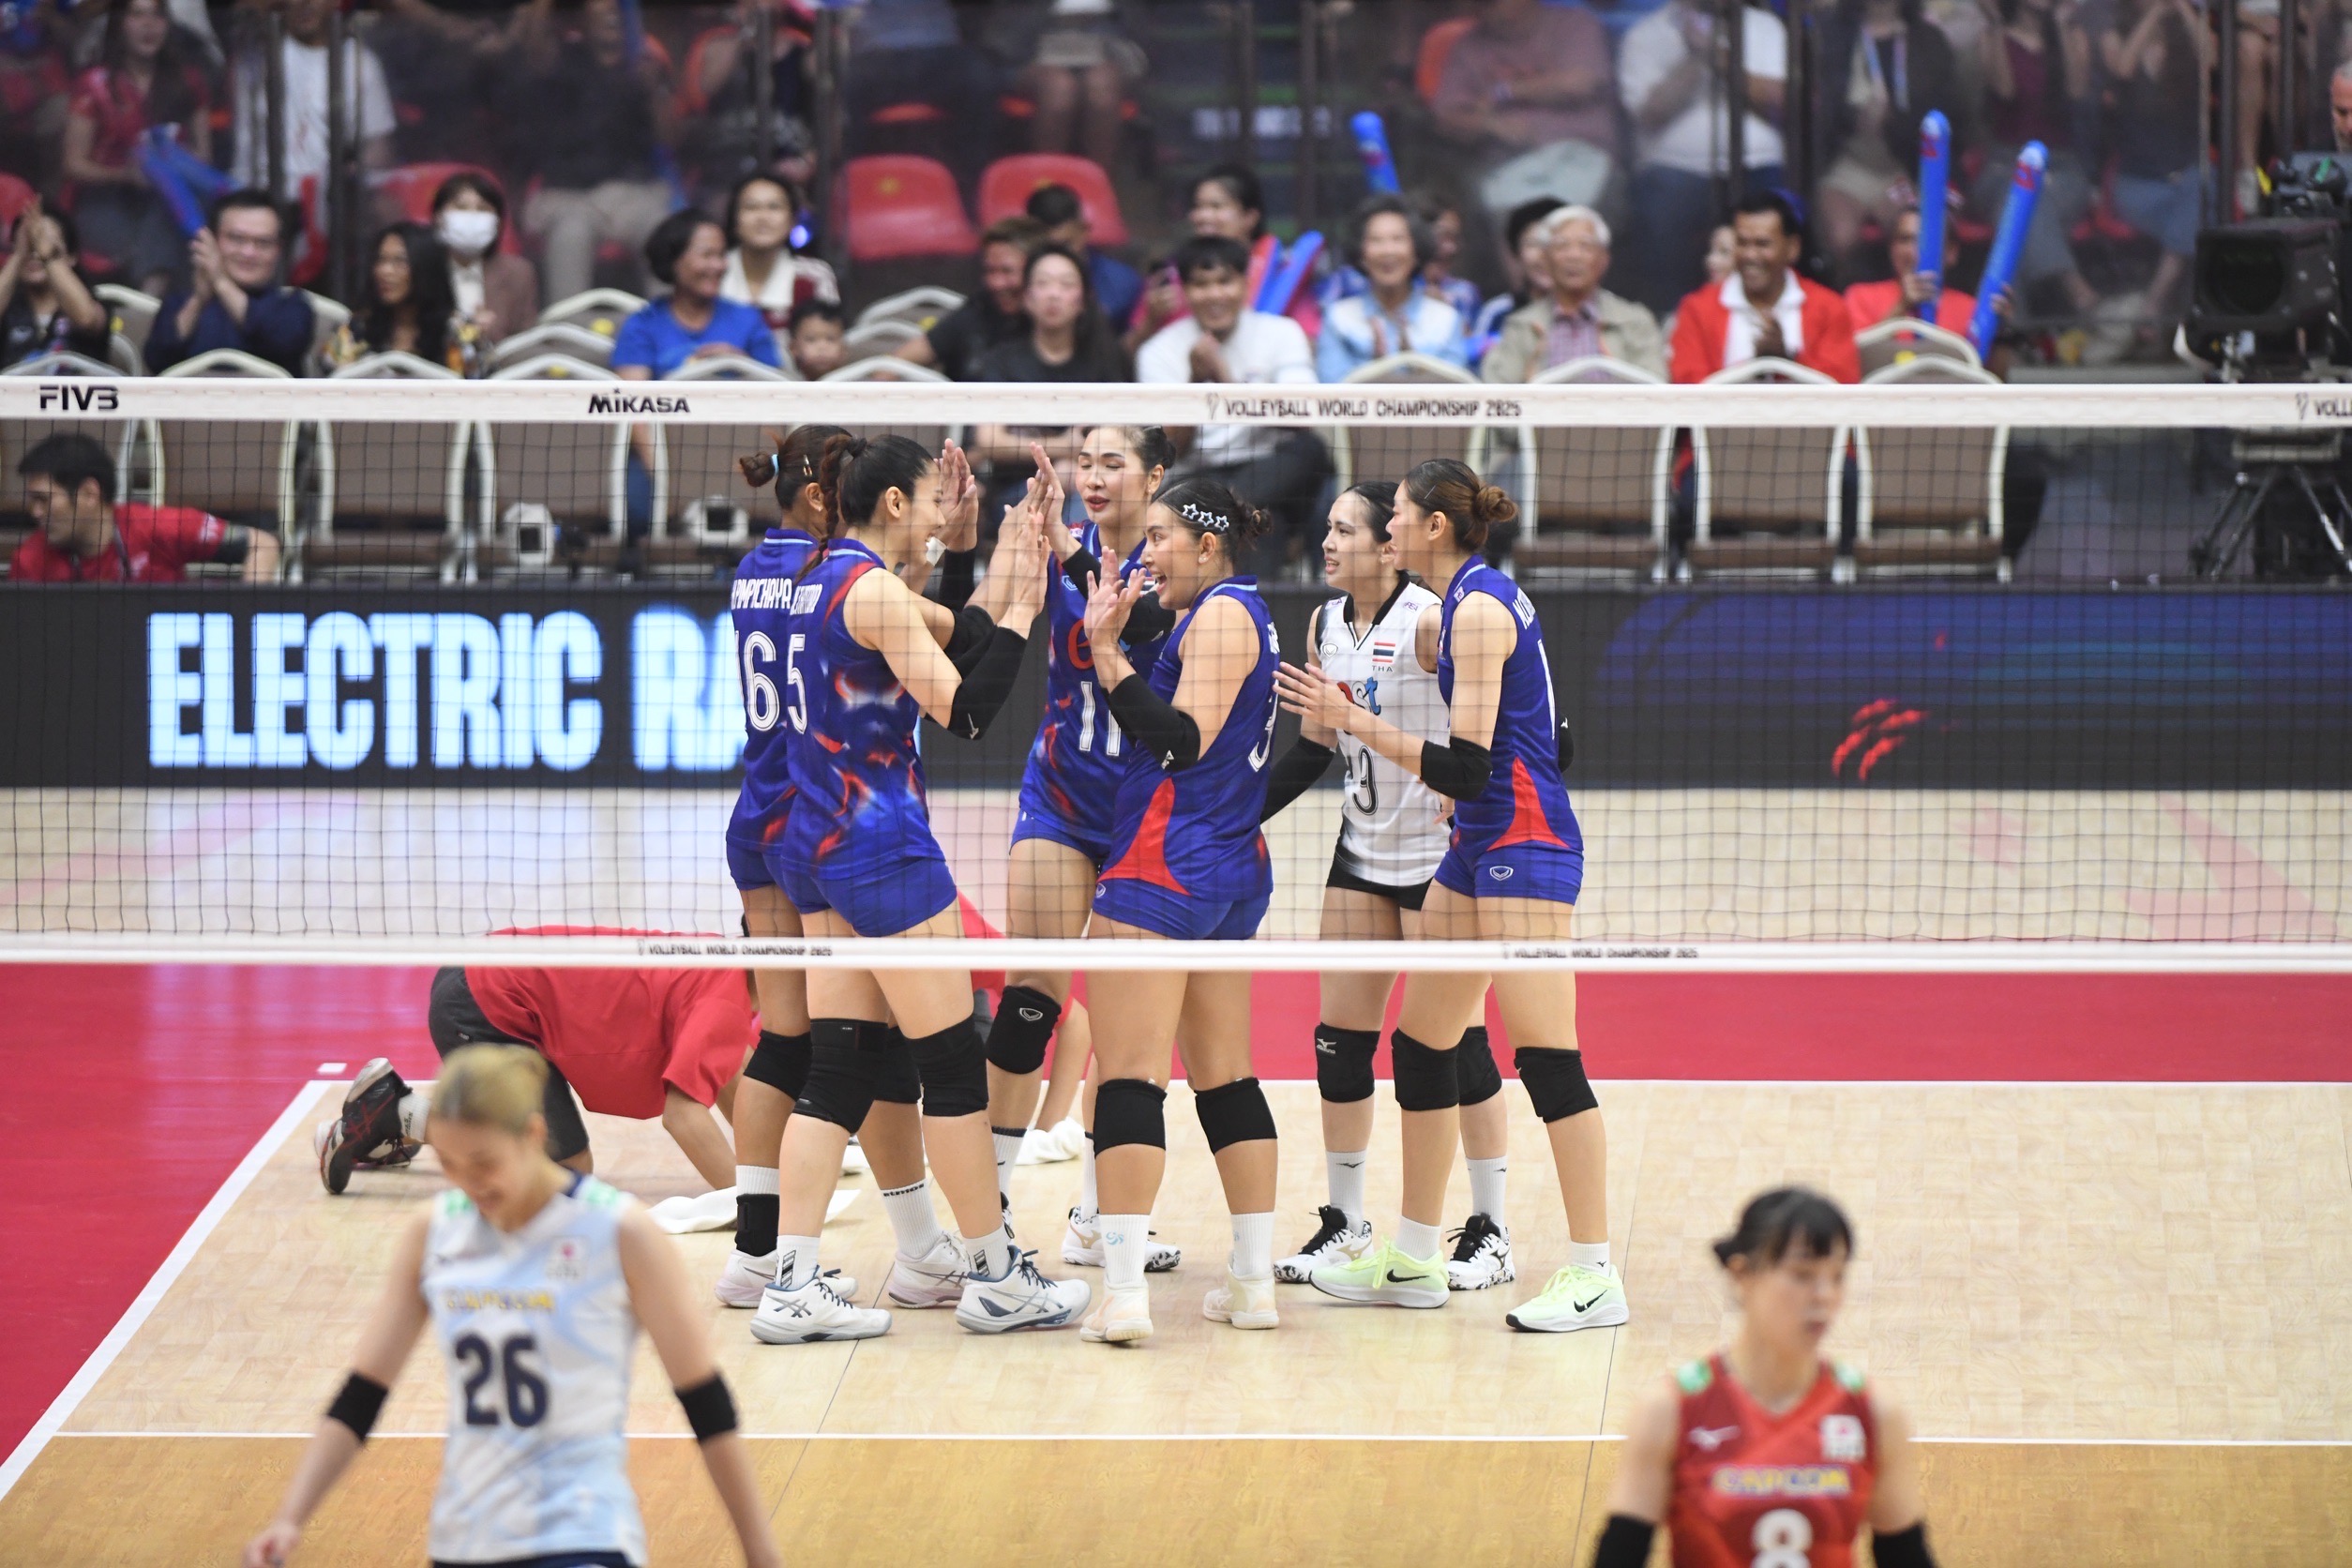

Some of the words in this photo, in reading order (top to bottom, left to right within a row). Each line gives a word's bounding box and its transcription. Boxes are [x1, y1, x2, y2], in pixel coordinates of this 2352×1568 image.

[1224, 399, 1310, 416] VOLLEYBALL
[1318, 399, 1368, 416] WORLD
[1376, 399, 1479, 416] CHAMPIONSHIP
[1485, 399, 1522, 417] 2025
[148, 611, 603, 770] ELECTRIC
[1372, 664, 1394, 672] THA
[1078, 681, 1122, 757] 11
[454, 1331, 550, 1428] 26
